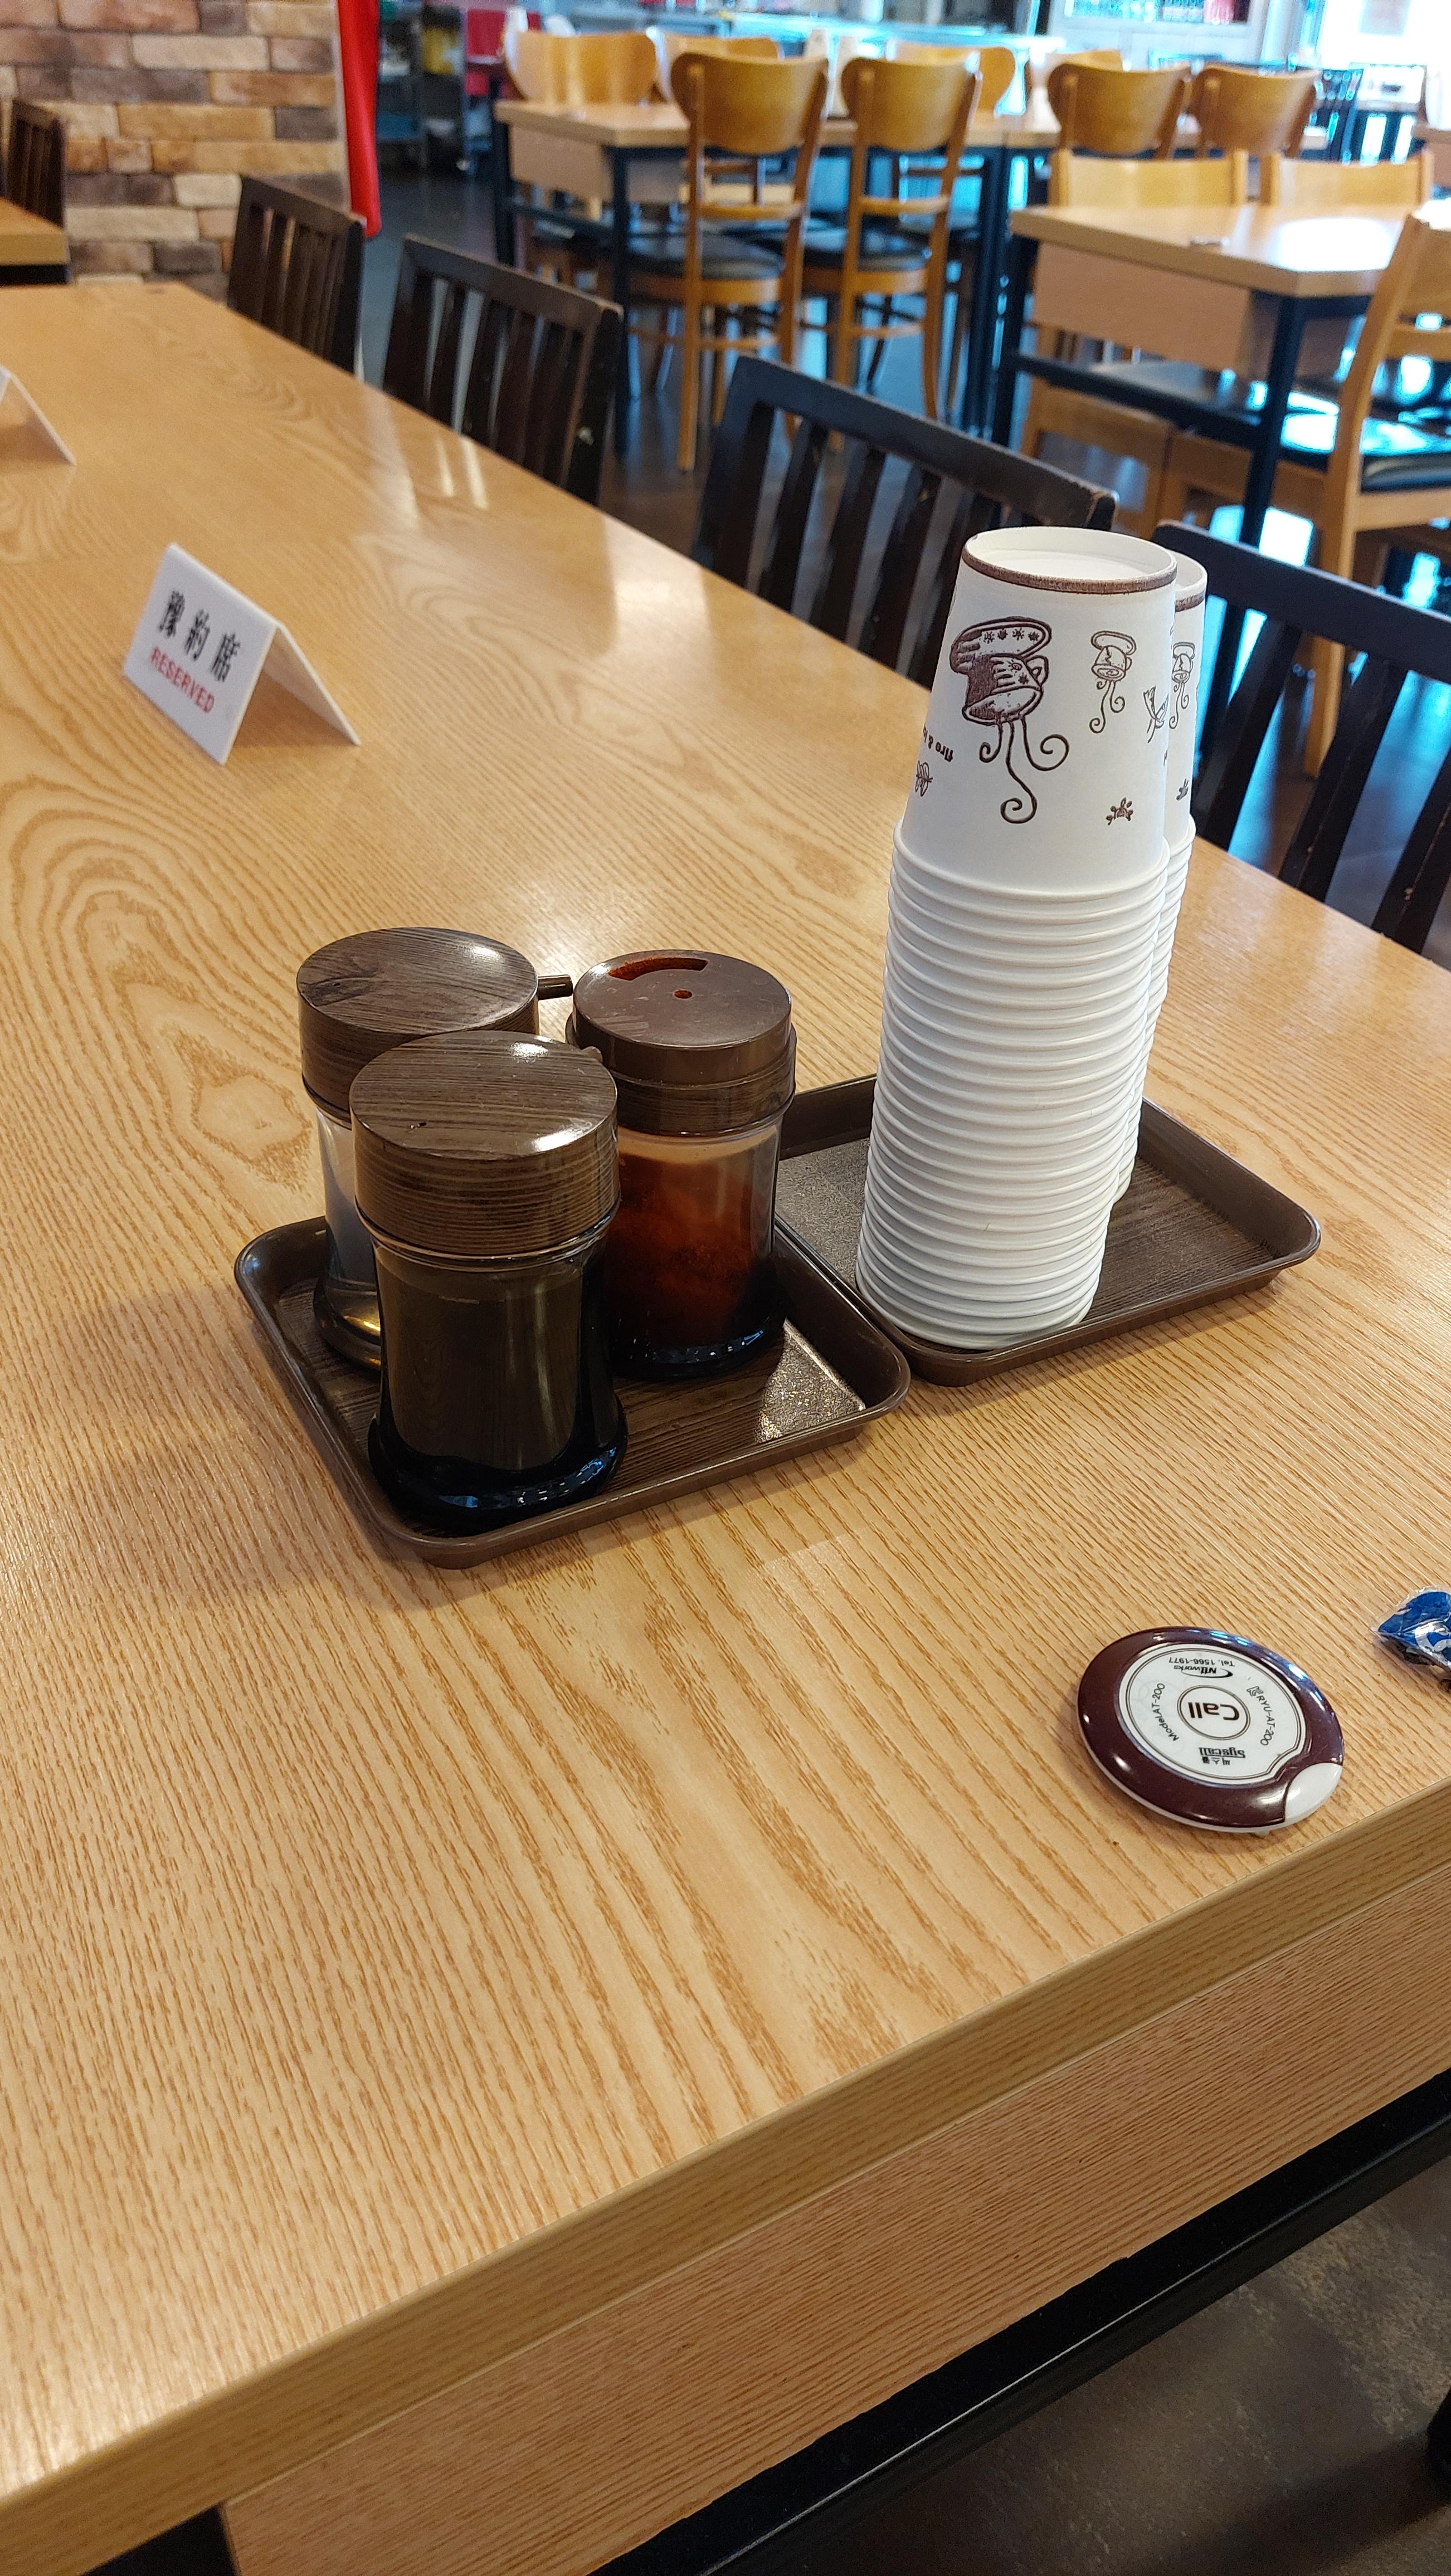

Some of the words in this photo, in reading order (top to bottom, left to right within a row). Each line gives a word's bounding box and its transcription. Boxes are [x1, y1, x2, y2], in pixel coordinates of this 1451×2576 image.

[150, 646, 215, 714] RESERVED
[1168, 1657, 1215, 1665] 1566-1977
[1188, 1701, 1240, 1721] Call
[1256, 1695, 1275, 1746] RYU-AT-200
